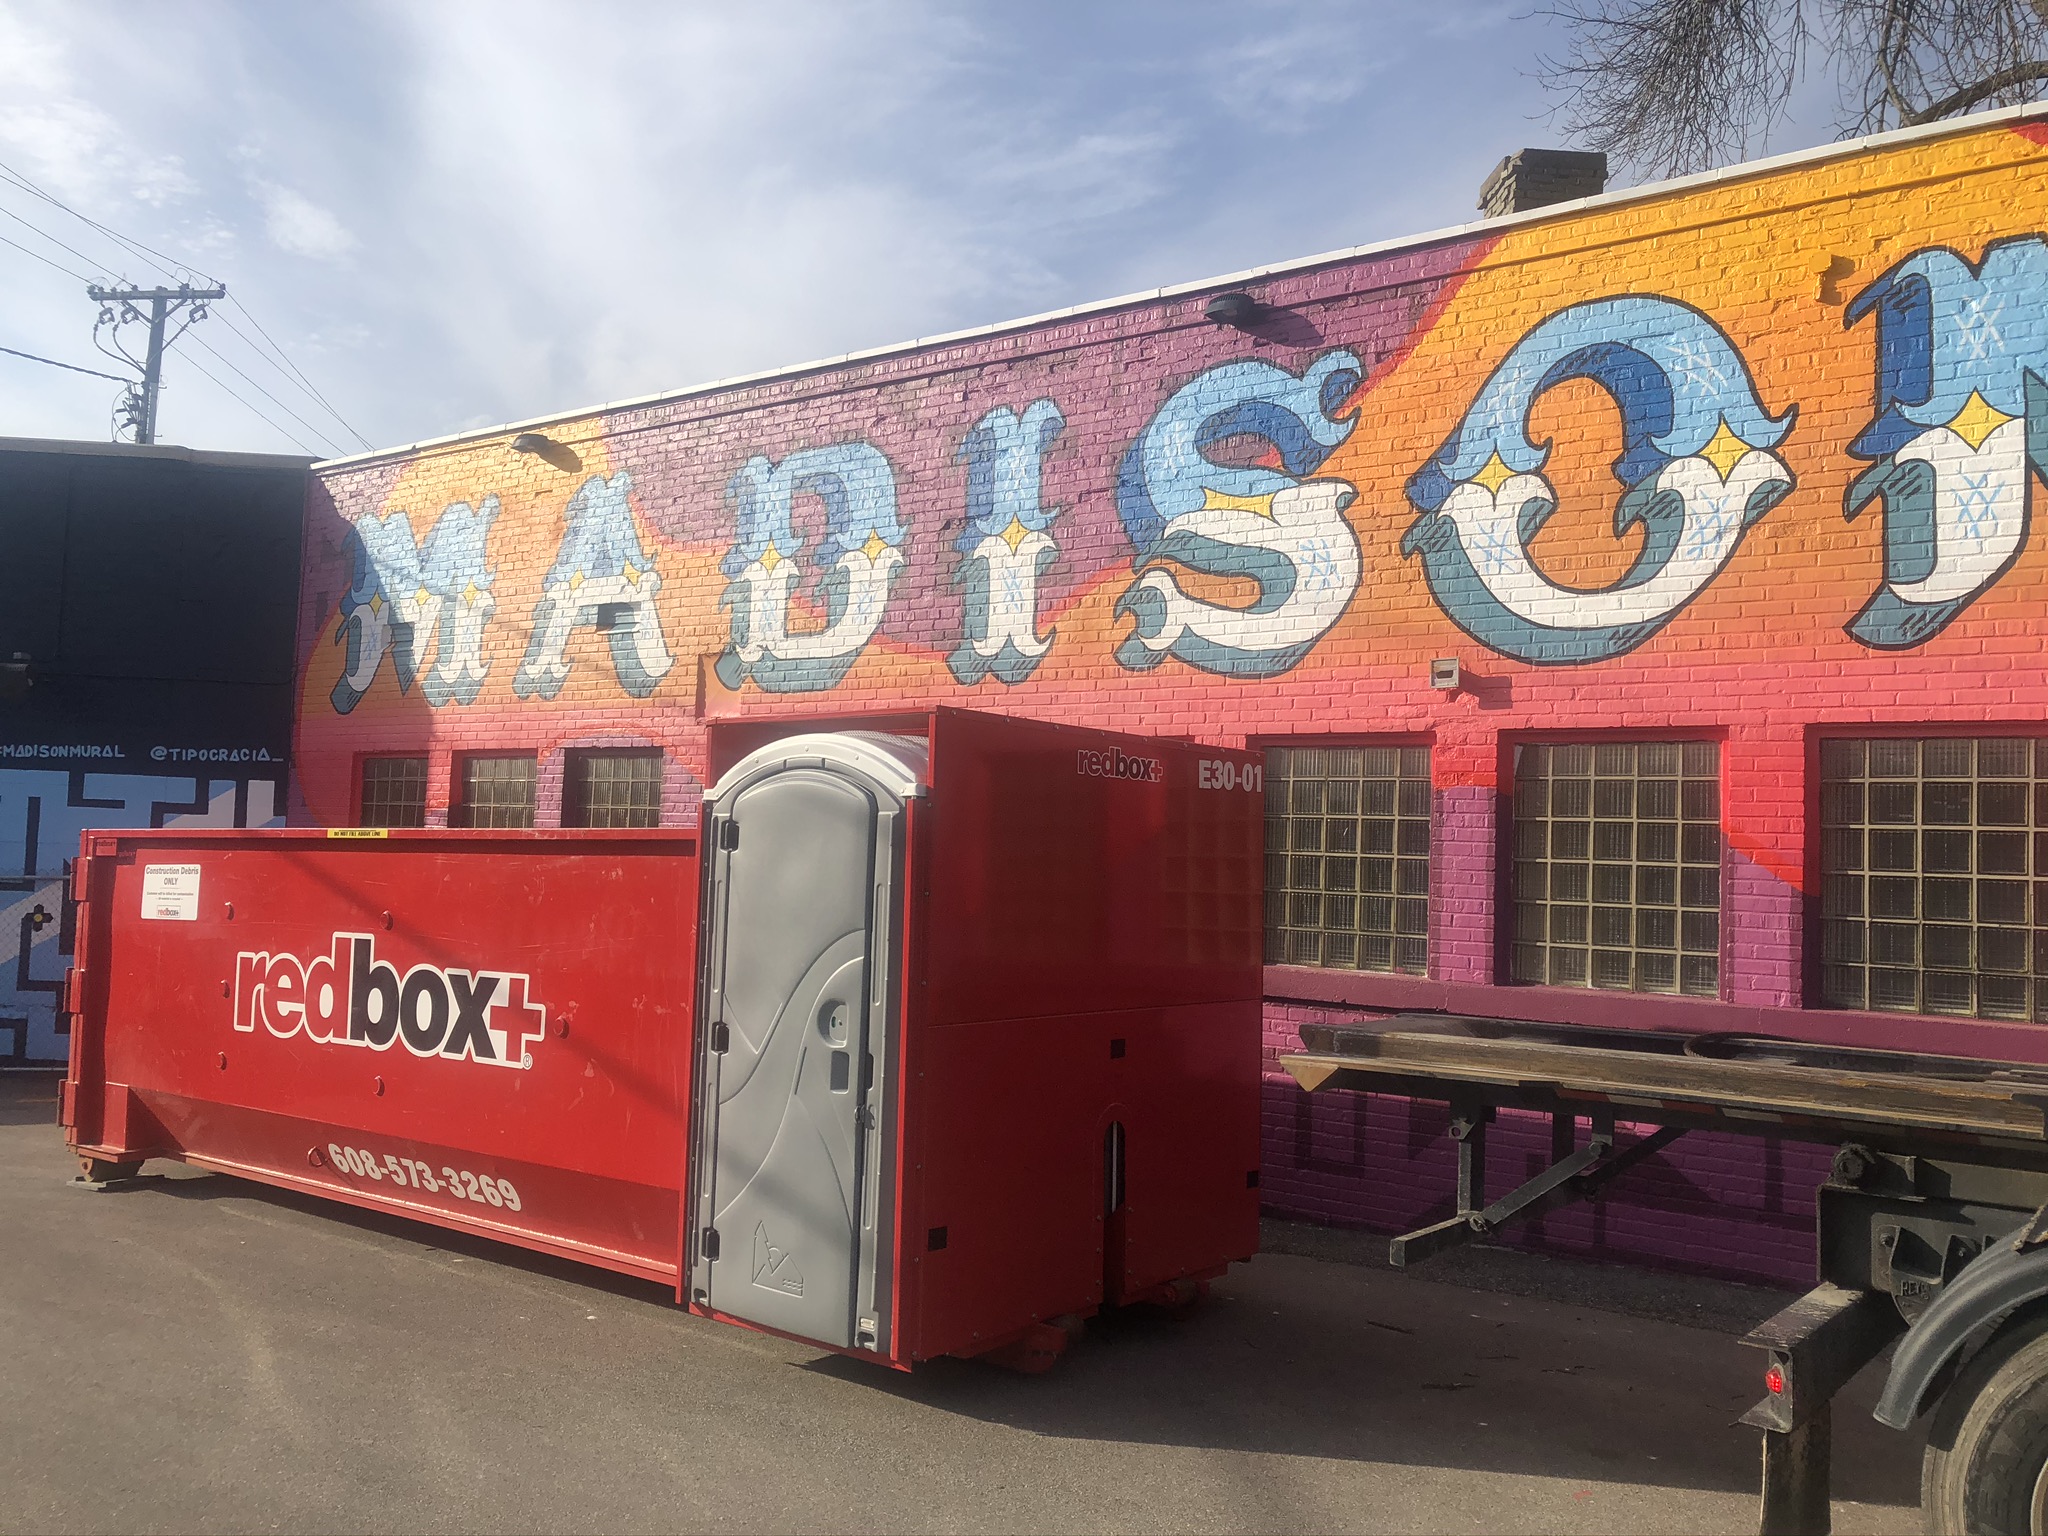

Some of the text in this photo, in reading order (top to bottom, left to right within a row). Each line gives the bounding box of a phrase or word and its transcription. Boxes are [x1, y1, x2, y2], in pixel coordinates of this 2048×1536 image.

[0, 744, 126, 758] MADISONMURAL
[1198, 759, 1263, 793] E30-01
[146, 866, 199, 875] Construction Debris
[163, 877, 179, 886] ONLY
[327, 1142, 522, 1212] 608-573-3269
